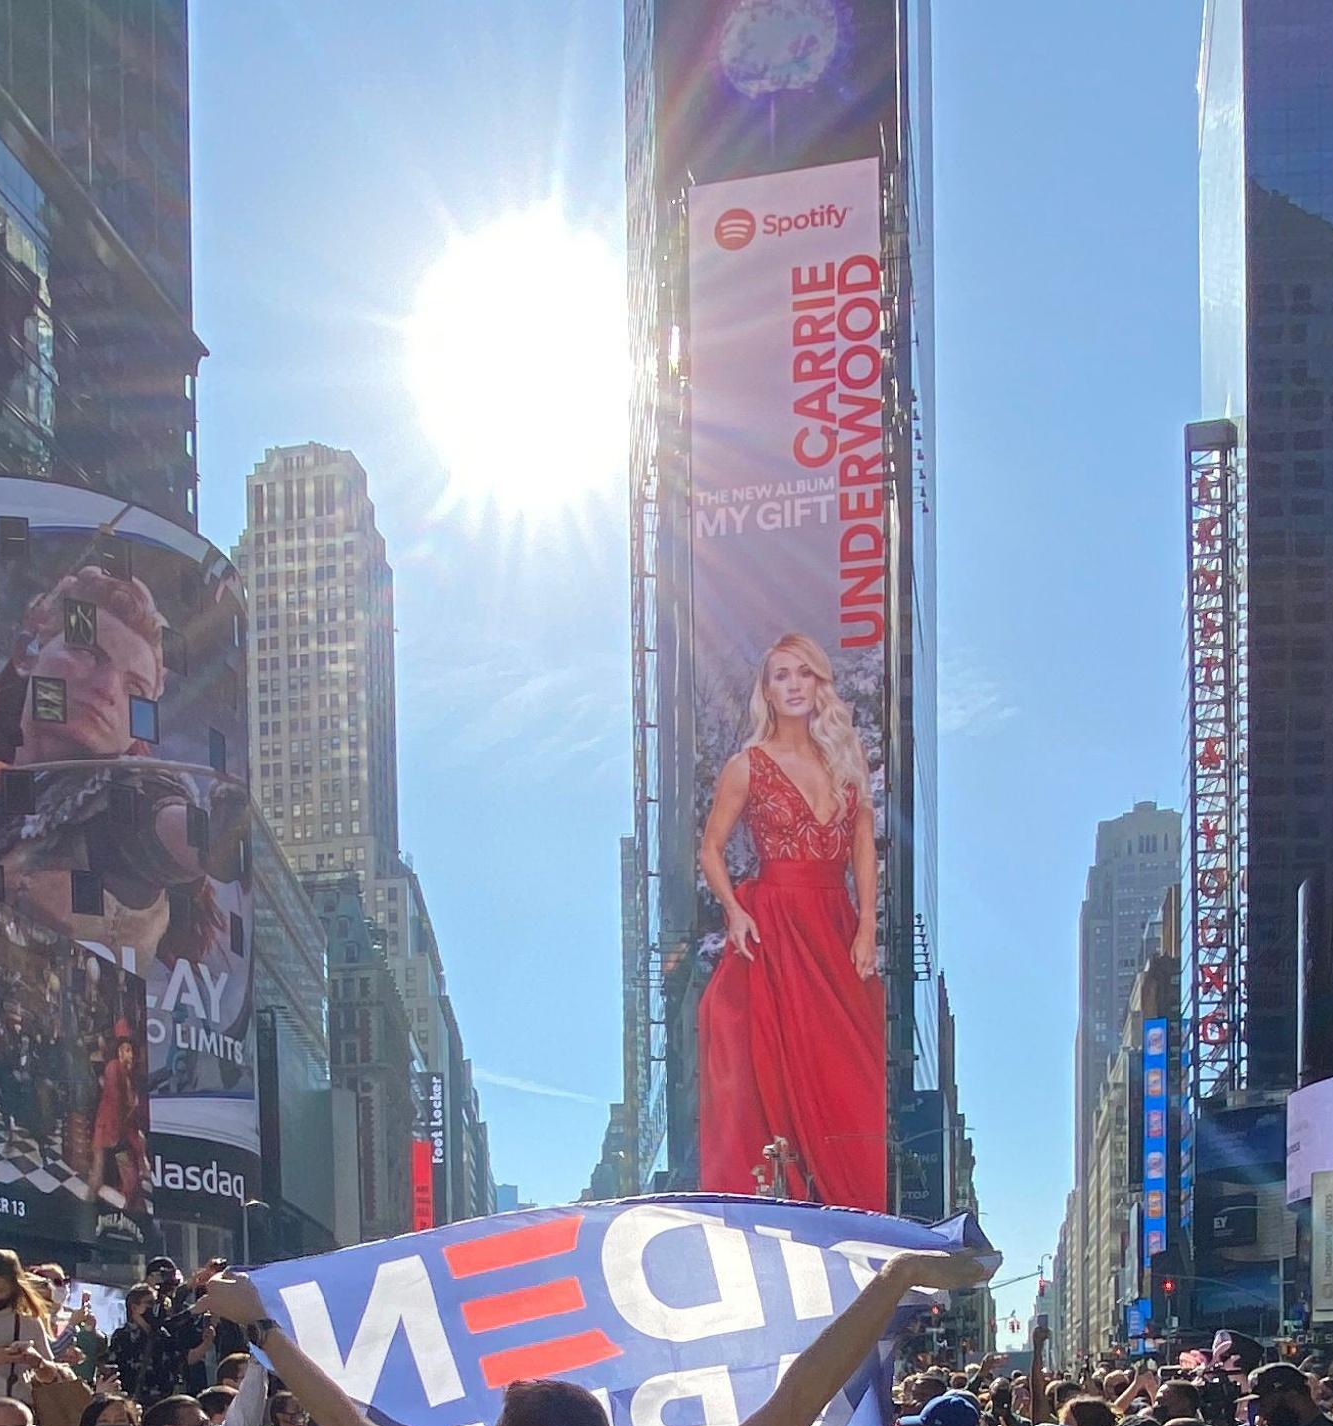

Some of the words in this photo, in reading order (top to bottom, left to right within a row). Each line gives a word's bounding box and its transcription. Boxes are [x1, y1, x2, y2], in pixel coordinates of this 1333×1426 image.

[763, 204, 848, 237] Spotify
[792, 262, 837, 469] CARRIE
[837, 254, 886, 649] UNDERWOOD
[697, 488, 729, 506] THE
[732, 485, 773, 501] NEW
[775, 475, 835, 498] ALBUM
[696, 505, 751, 538] MY
[755, 494, 836, 531] GIFT
[429, 1076, 443, 1126] Locker
[150, 1155, 245, 1207] Nasdaq
[12, 1199, 26, 1217] 13
